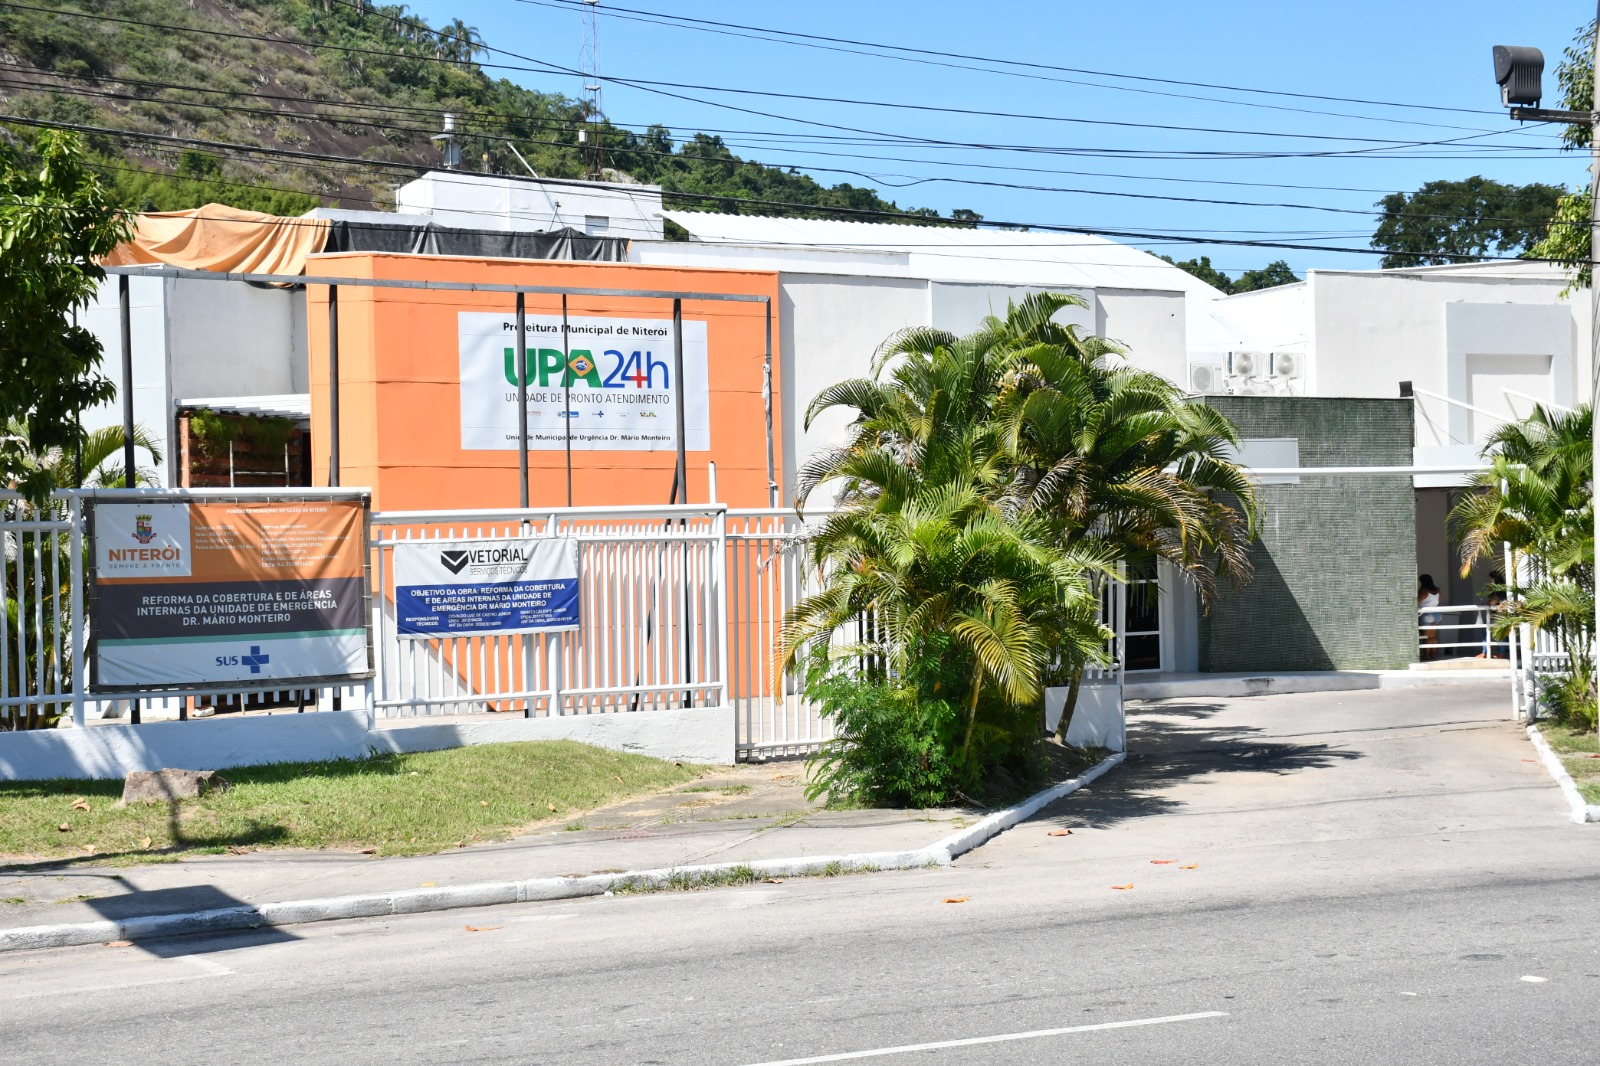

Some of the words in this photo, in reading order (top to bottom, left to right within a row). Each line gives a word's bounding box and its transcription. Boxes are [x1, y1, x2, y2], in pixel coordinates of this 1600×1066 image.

[503, 322, 558, 333] Preitura
[561, 324, 613, 336] Municipal
[616, 326, 629, 335] de
[632, 327, 668, 336] Niterói
[505, 392, 548, 403] UNDADE
[550, 393, 562, 403] DE
[605, 394, 670, 404] ATENDIMENTO
[535, 434, 569, 442] Municipa
[579, 434, 608, 442] Urgência
[108, 544, 180, 562] NITERÓI
[469, 549, 528, 563] VETORIAL
[469, 565, 499, 577] SERVIÇOS
[500, 564, 528, 574] TÉCNICOS
[142, 595, 194, 605] REFORMA
[196, 594, 211, 604] DA
[212, 592, 274, 603] COBERTURA
[276, 592, 283, 600] E
[284, 591, 298, 600] DE
[299, 588, 332, 600] ÁREAS
[410, 589, 445, 597] OBJETIVO
[446, 588, 457, 596] DA
[457, 588, 480, 596] OBRA:
[480, 586, 513, 594] REFORMA
[524, 583, 566, 592] COBERTURA
[467, 594, 501, 602] INTERNAS
[512, 592, 542, 600] UNIDADE
[542, 591, 553, 599] DE
[137, 606, 191, 616] INTERNAS
[193, 605, 208, 614] DA
[209, 603, 256, 614] UNIDADE
[258, 602, 271, 612] DE
[273, 599, 338, 611] EMERGÊNCIA
[431, 604, 478, 612] EMERGÊNCIA
[478, 603, 489, 611] DR
[489, 602, 513, 610] MÁRIO
[512, 600, 547, 608] MONTEIRO
[182, 616, 200, 626] DR.
[202, 613, 236, 625] MÁRIO
[238, 613, 291, 624] MONTEIRO
[215, 655, 239, 666] SUS
